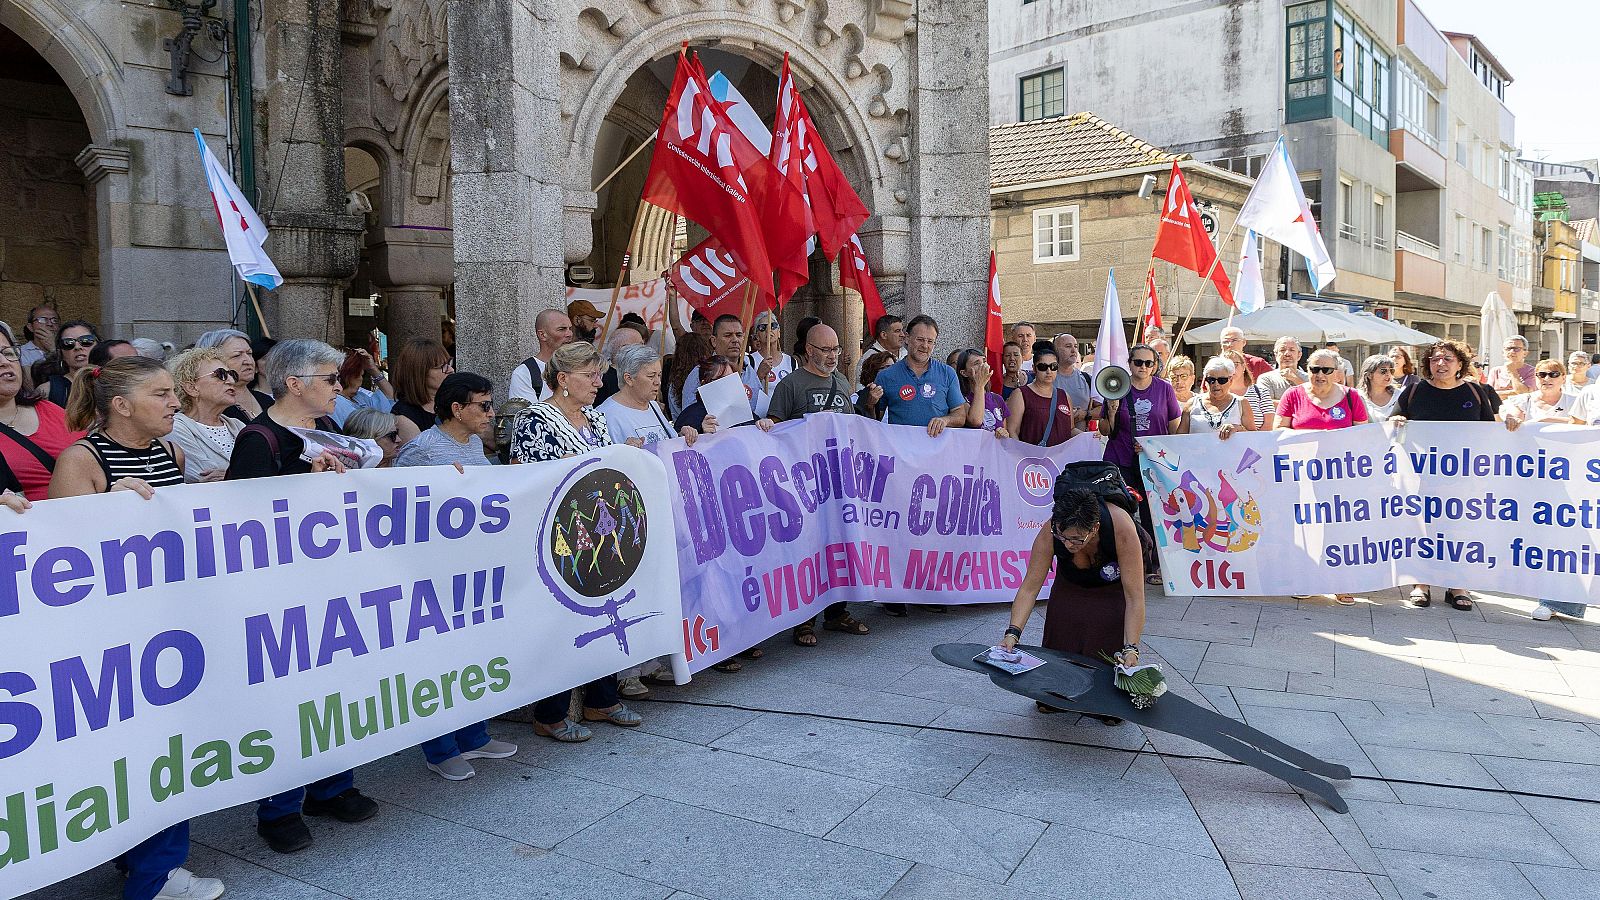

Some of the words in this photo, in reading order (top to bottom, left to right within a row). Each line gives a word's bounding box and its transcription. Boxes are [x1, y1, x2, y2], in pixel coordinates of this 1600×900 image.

[1024, 471, 1050, 490] CIG
[1272, 450, 1373, 483] Fronte
[1383, 445, 1397, 475] á
[1409, 446, 1571, 481] violencia
[672, 437, 895, 566] Descoidar
[907, 464, 1003, 537] coida
[1294, 494, 1371, 525] unha
[1381, 492, 1519, 525] resposta
[0, 486, 511, 618] feminicidios
[1190, 559, 1246, 590] CIG
[1325, 533, 1497, 569] subversiva,
[742, 565, 761, 613] é
[245, 565, 506, 686] MATA!!!
[682, 613, 720, 664] IG
[149, 733, 276, 803] das
[298, 656, 512, 760] Mulleres
